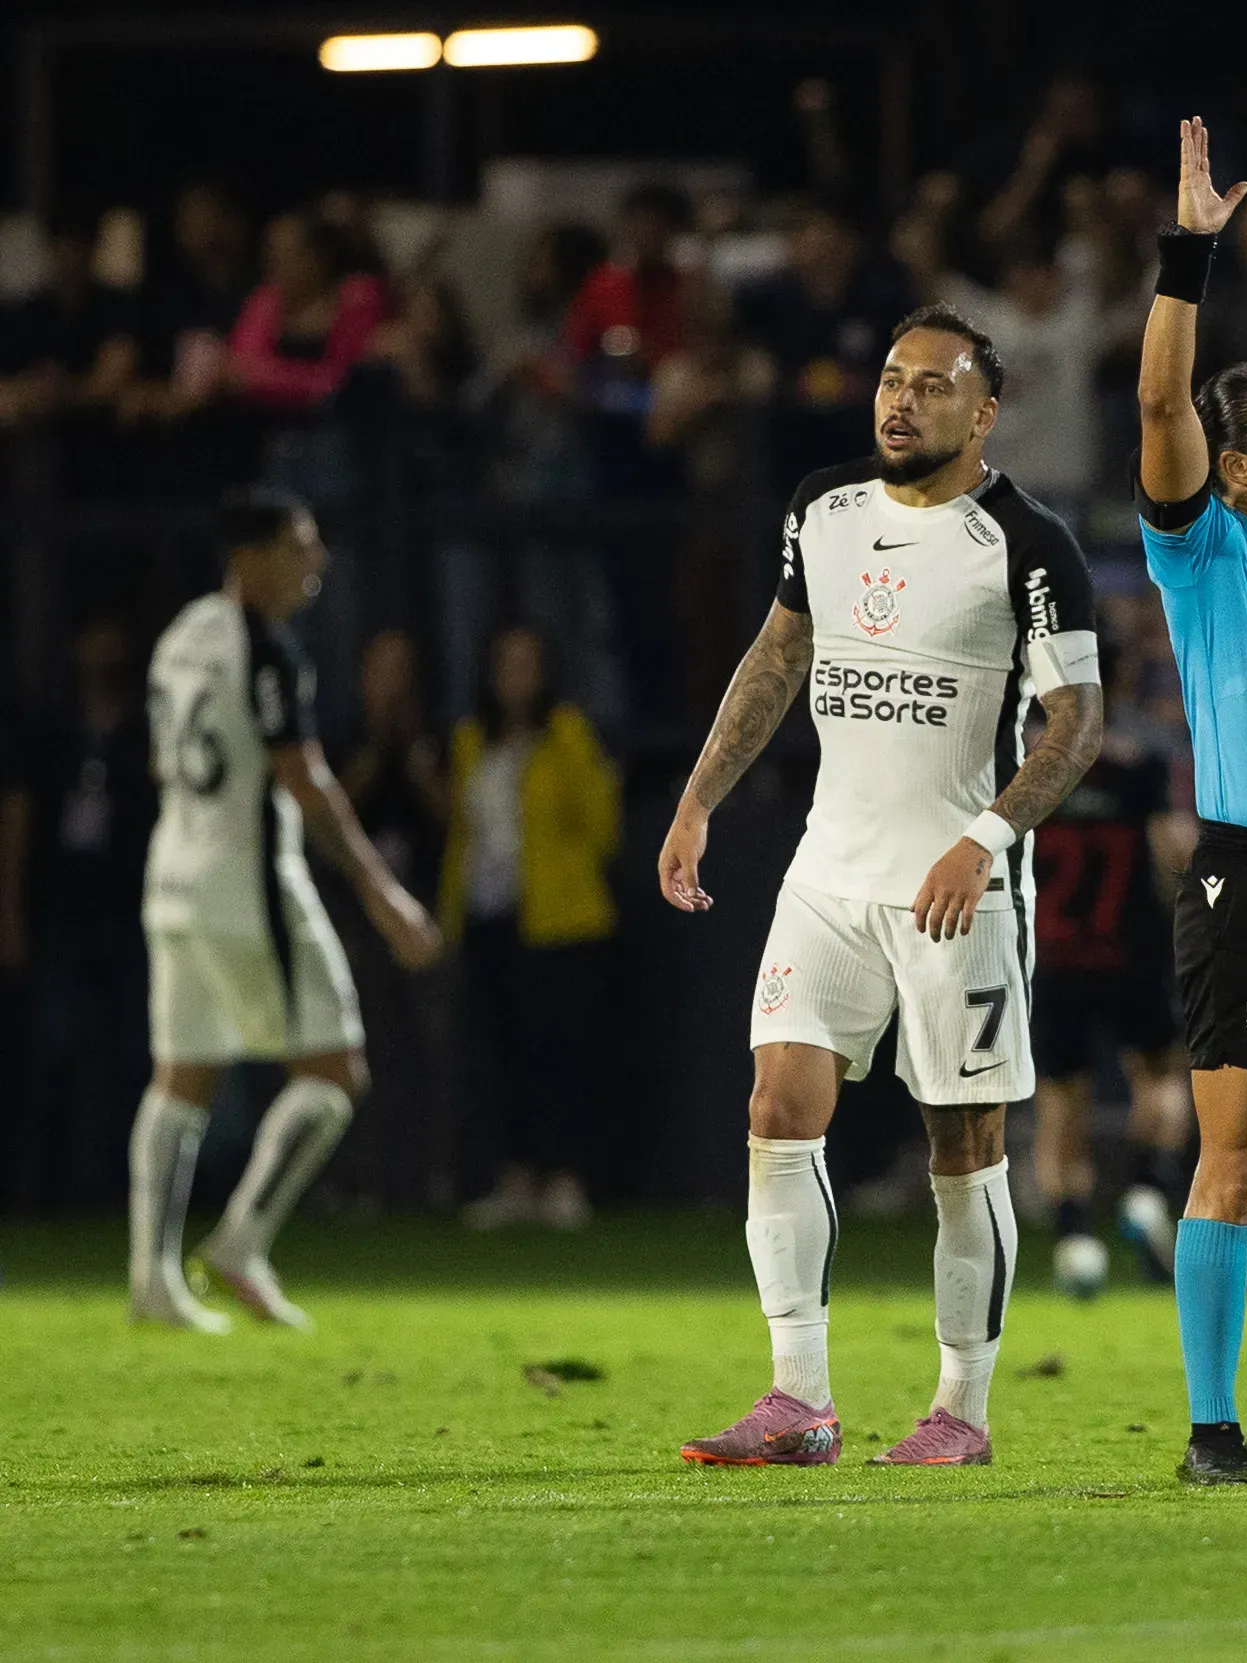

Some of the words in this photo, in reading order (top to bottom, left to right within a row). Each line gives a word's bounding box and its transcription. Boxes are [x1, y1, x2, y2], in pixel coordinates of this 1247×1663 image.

[828, 493, 849, 510] Zé
[965, 510, 999, 546] Frimesa
[1048, 602, 1059, 631] banco
[815, 660, 959, 698] Esportes
[1035, 822, 1136, 940] 27
[964, 984, 1009, 1052] 7
